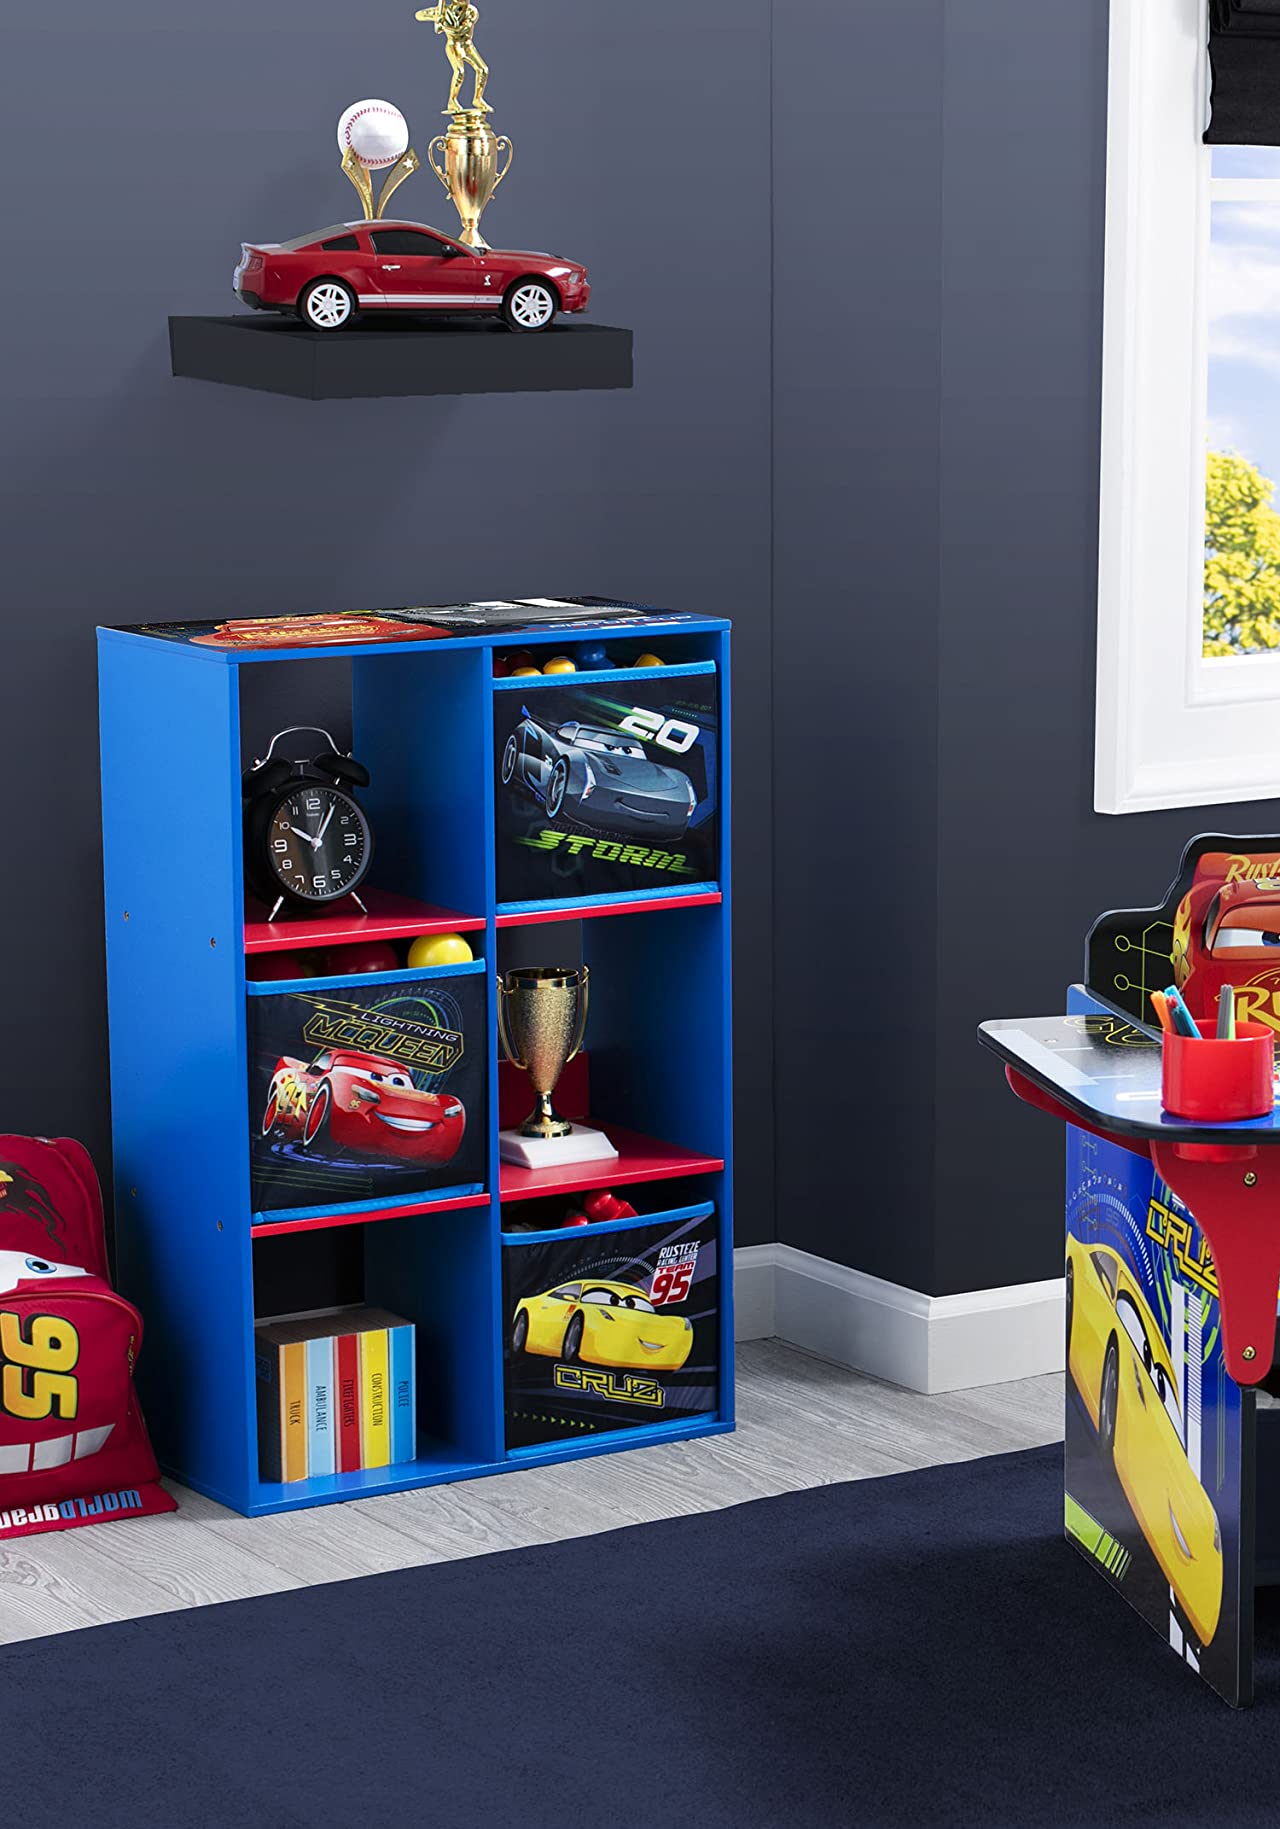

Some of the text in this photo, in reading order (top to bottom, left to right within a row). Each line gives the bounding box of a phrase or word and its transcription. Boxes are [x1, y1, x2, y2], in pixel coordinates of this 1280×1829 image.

[306, 798, 321, 811] 12
[279, 821, 290, 831] 10
[274, 839, 288, 853] 9
[344, 833, 357, 846] 3
[535, 829, 690, 872] STORM
[282, 860, 293, 870] 8
[343, 855, 353, 864] 4
[294, 875, 305, 884] 7
[313, 875, 327, 888] 6
[331, 869, 341, 879] 5
[360, 1012, 459, 1043] LIGHTNING
[309, 1013, 458, 1067] MCQUEEN
[659, 1240, 701, 1259] RUSTEZE
[650, 1269, 693, 1306] 95
[1, 1311, 79, 1420] 95
[397, 1380, 409, 1408] POLICE
[555, 1365, 664, 1408] CRUZ
[315, 1385, 328, 1432] AMBULANCE
[371, 1372, 383, 1427] CONSTRUCTION
[290, 1400, 301, 1426] TRUCK
